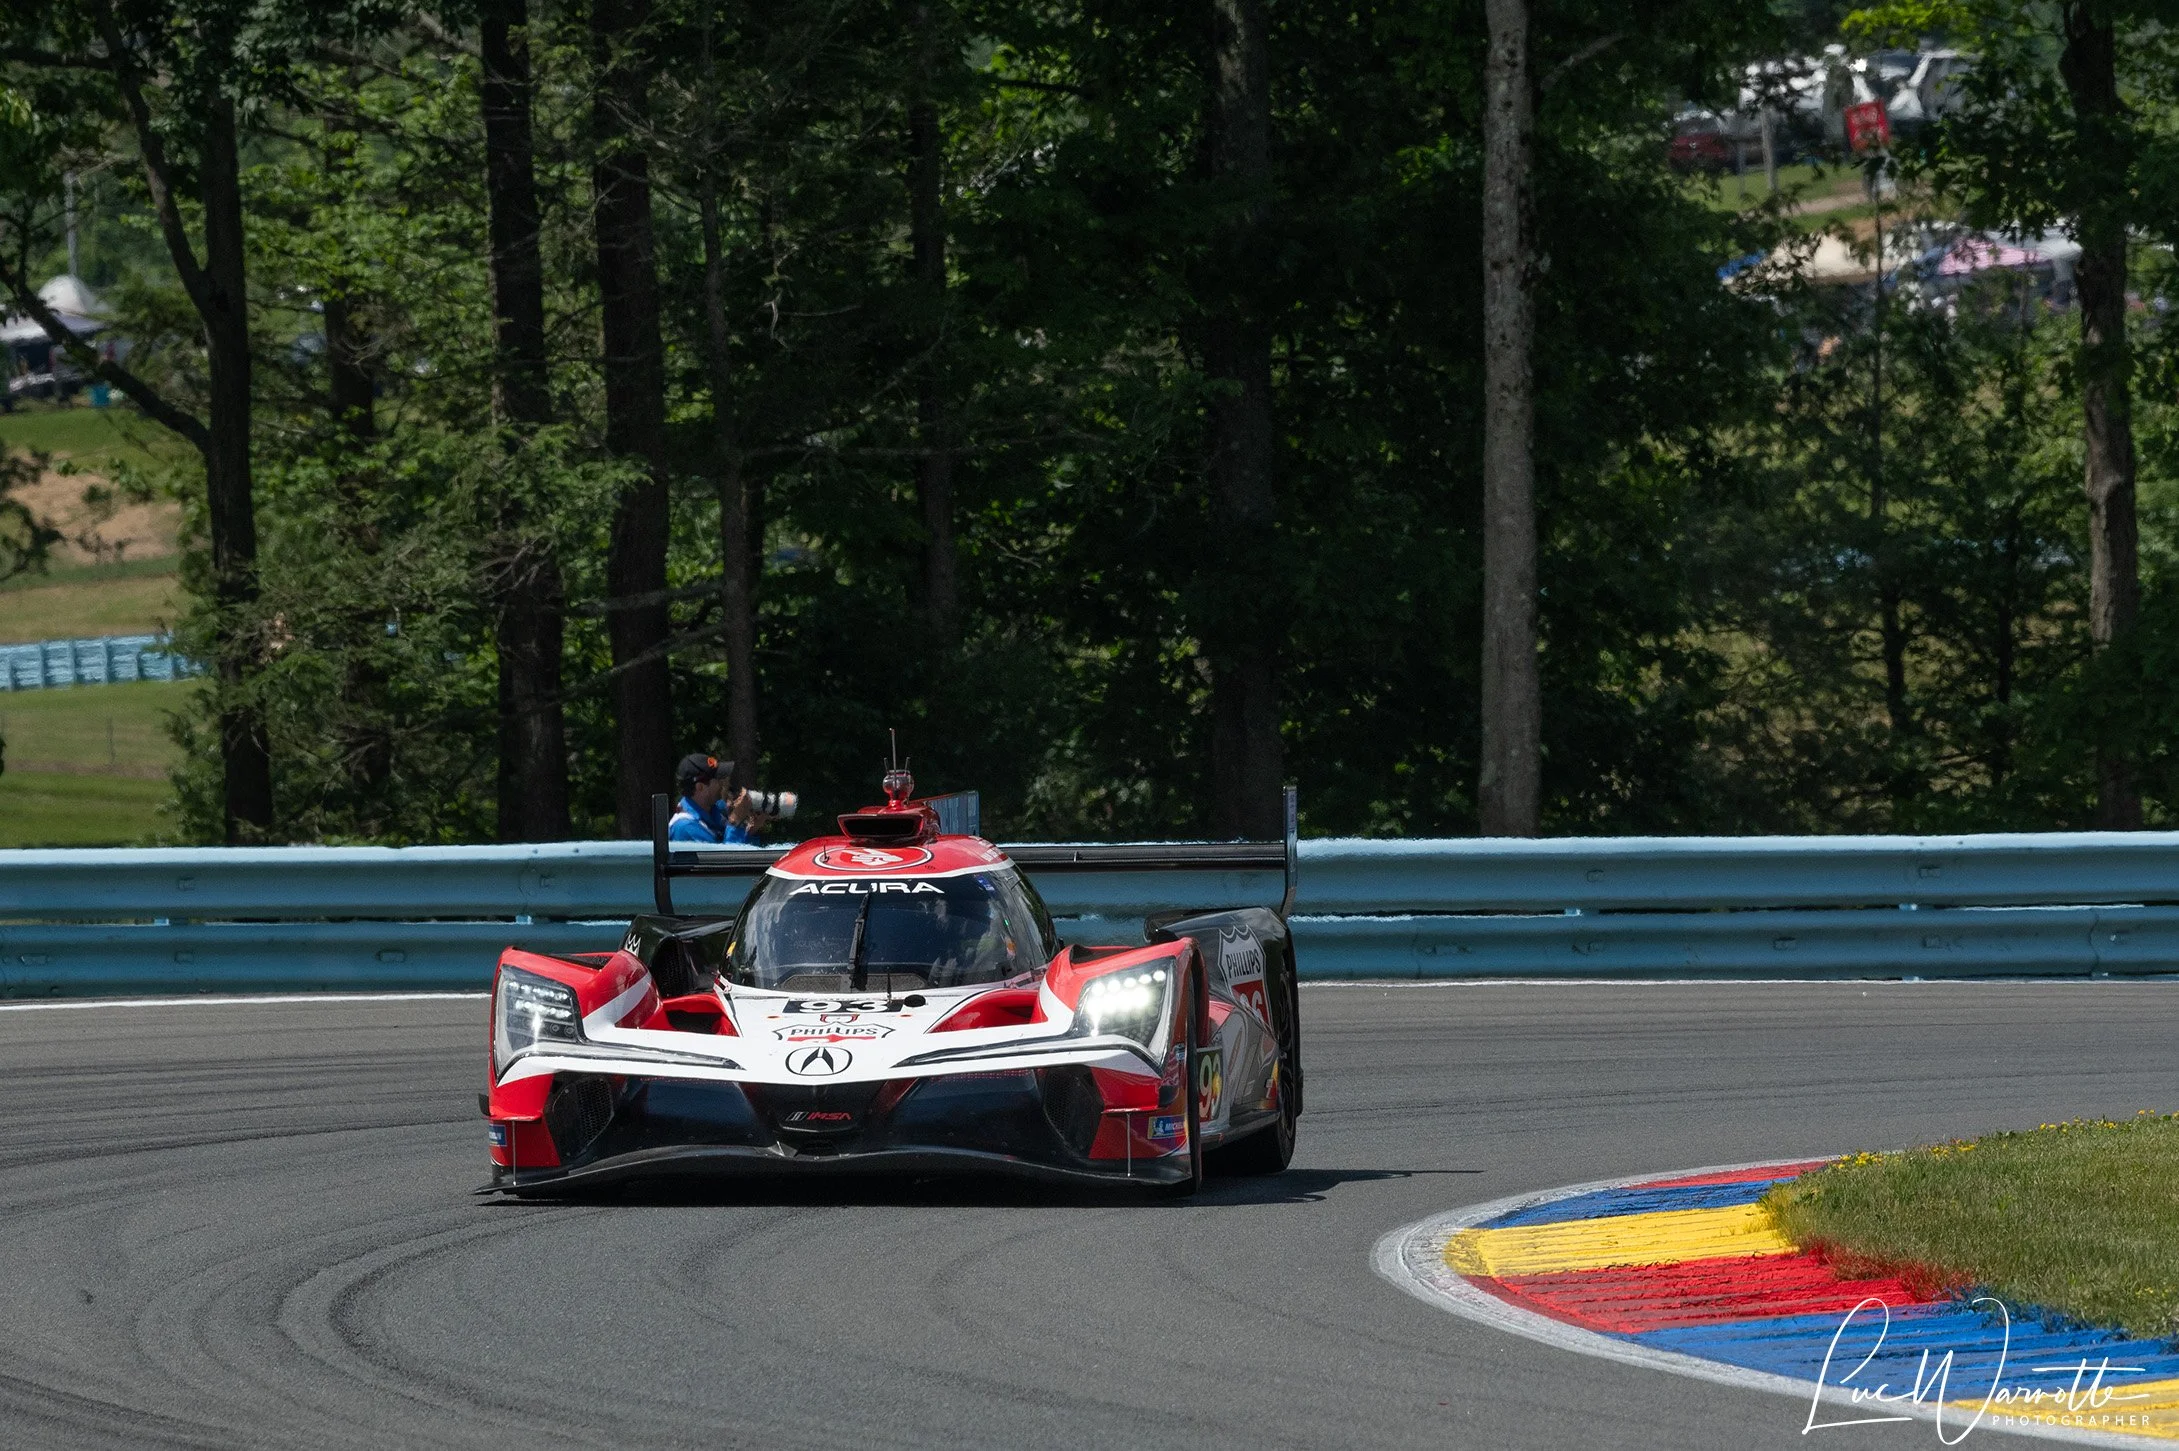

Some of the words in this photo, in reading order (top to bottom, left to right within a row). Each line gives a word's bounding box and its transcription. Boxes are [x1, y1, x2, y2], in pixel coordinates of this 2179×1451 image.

[788, 881, 945, 895] ACURA
[1225, 948, 1262, 979] PHILLIPS
[799, 1000, 890, 1013] 93
[790, 1026, 879, 1036] PHILLIPS
[807, 1111, 852, 1121] IMSA
